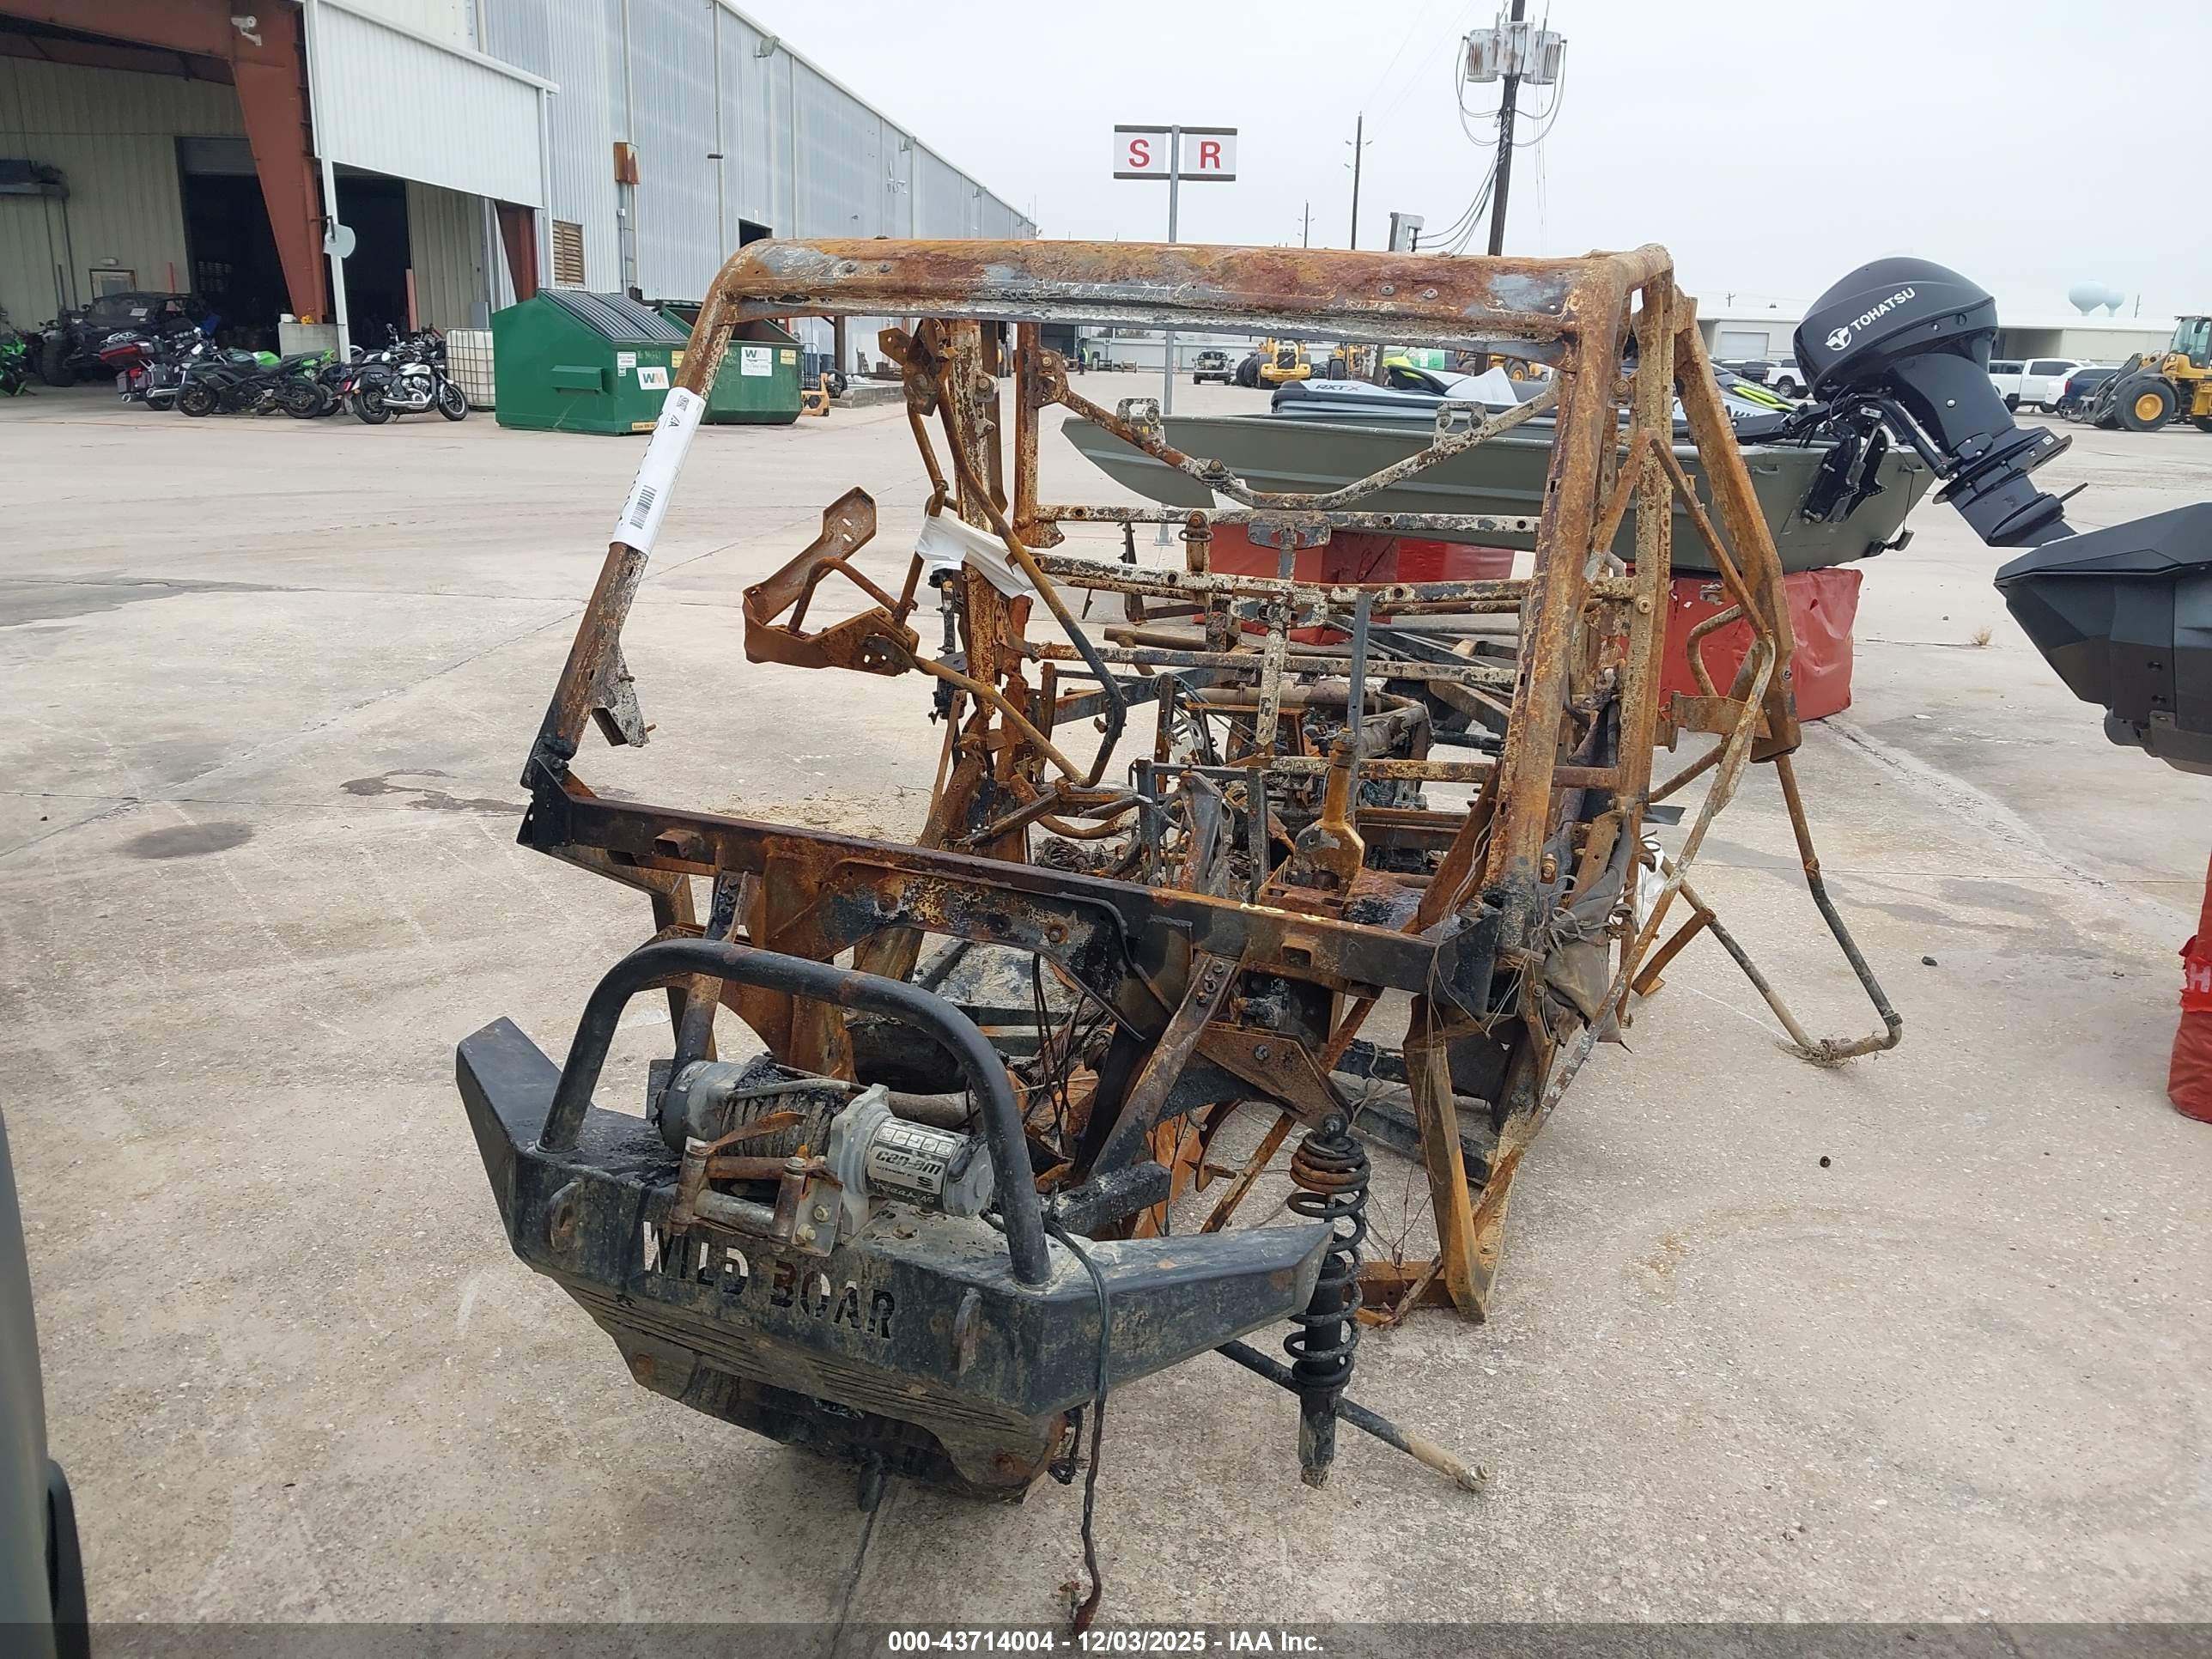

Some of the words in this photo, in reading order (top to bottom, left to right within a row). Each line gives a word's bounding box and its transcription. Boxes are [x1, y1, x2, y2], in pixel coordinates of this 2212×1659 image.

[1128, 138, 1151, 168] S
[1200, 141, 1221, 169] R
[1850, 287, 1916, 331] TOHATSU
[642, 1220, 749, 1296] WILD
[770, 1259, 896, 1340] BOAR
